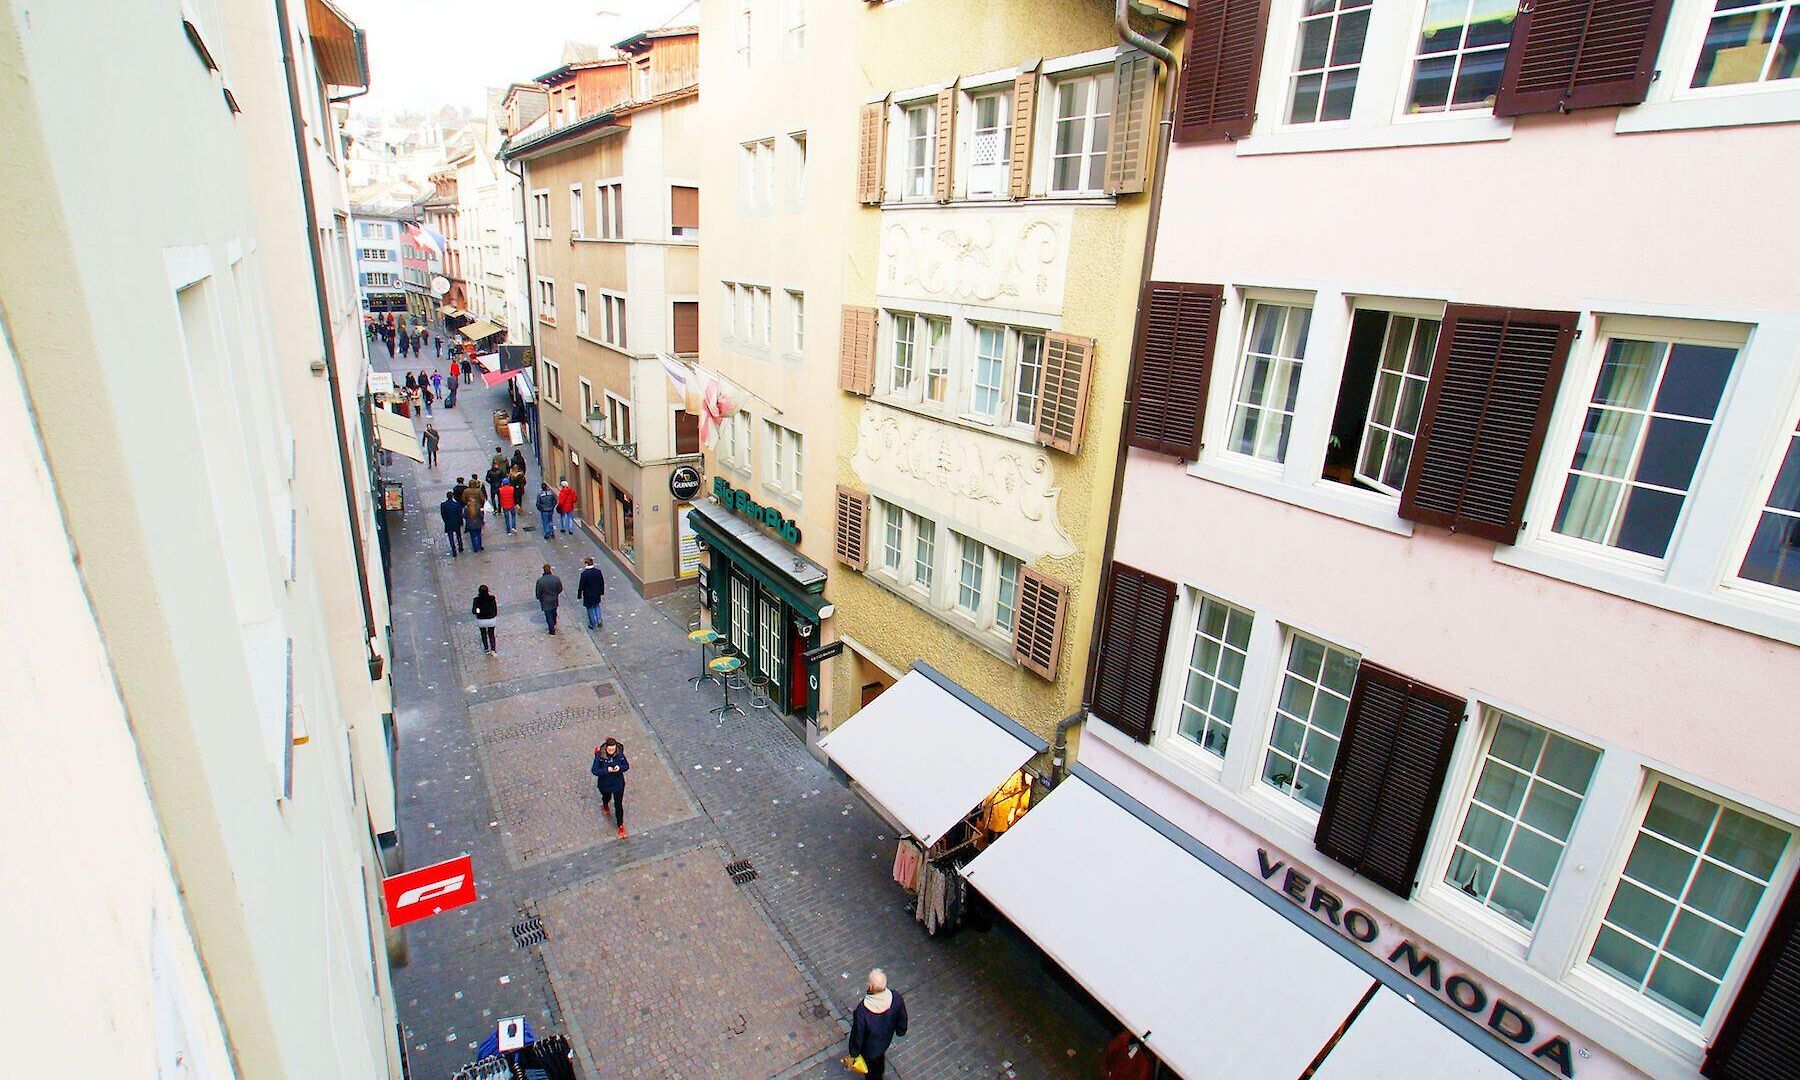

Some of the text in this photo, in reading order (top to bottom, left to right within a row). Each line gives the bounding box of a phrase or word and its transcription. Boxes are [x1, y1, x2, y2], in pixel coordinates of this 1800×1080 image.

[713, 476, 802, 545] Big Ben Pub
[1256, 848, 1574, 1079] VERO MODA
